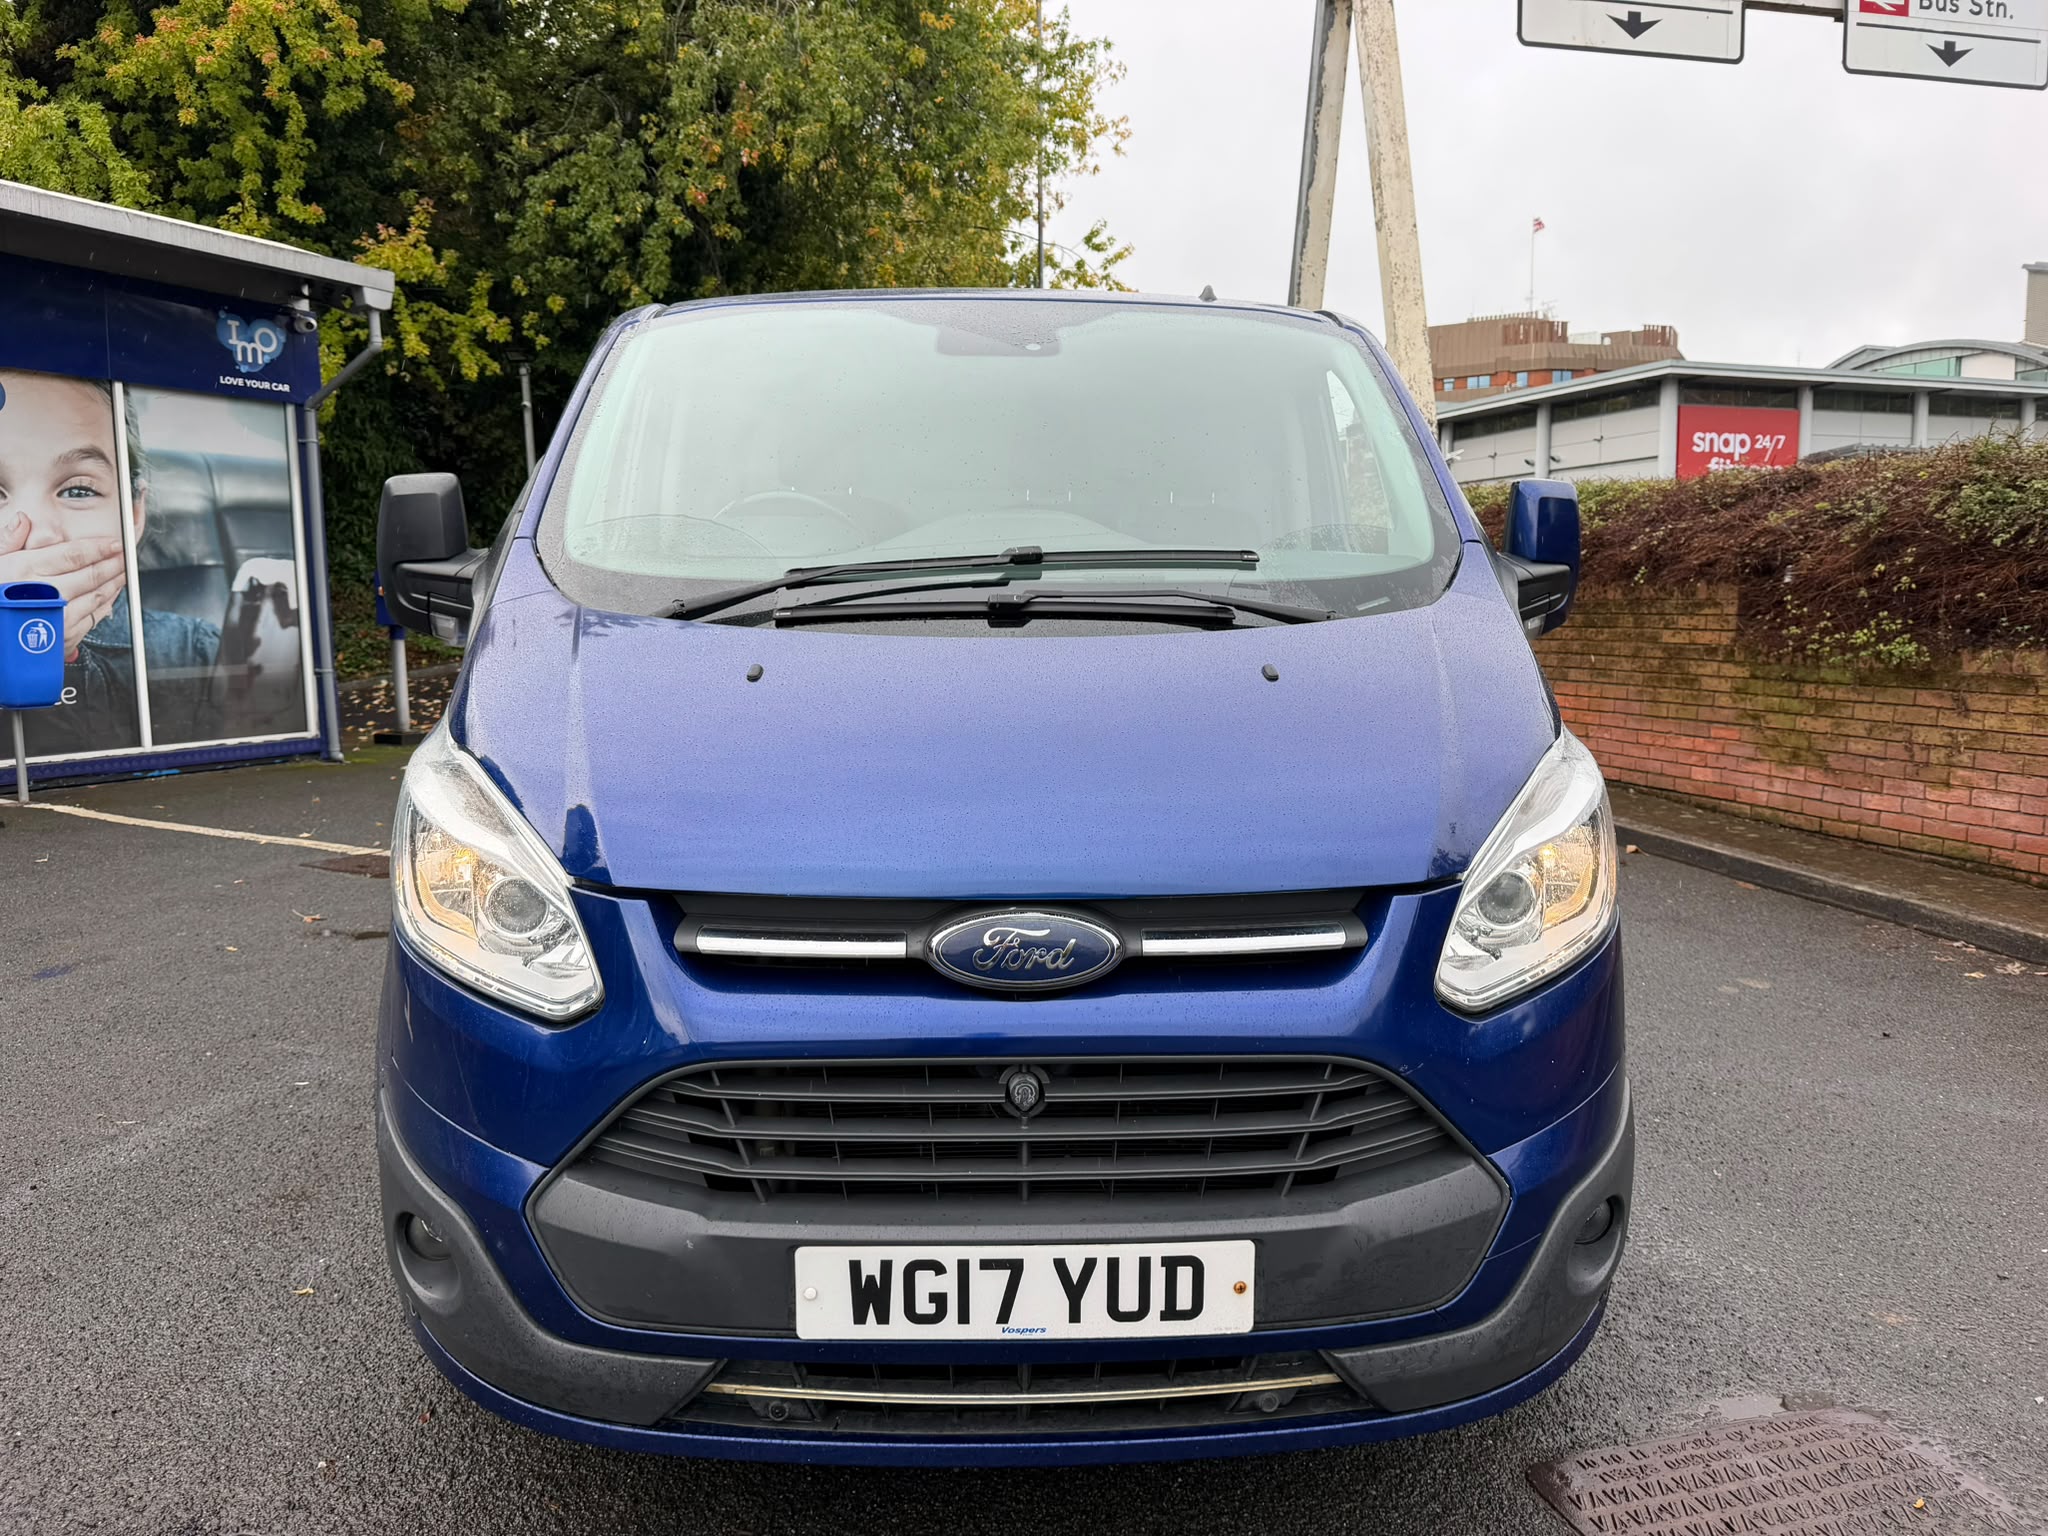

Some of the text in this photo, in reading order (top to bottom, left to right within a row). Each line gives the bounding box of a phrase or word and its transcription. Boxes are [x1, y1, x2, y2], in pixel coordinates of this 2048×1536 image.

[220, 376, 290, 392] LOVE YOUR CAR
[1692, 431, 1786, 462] snap 24/7
[973, 927, 1076, 971] Ford
[848, 1254, 1205, 1325] WG17 YUD
[1002, 1326, 1046, 1335] Vospers
